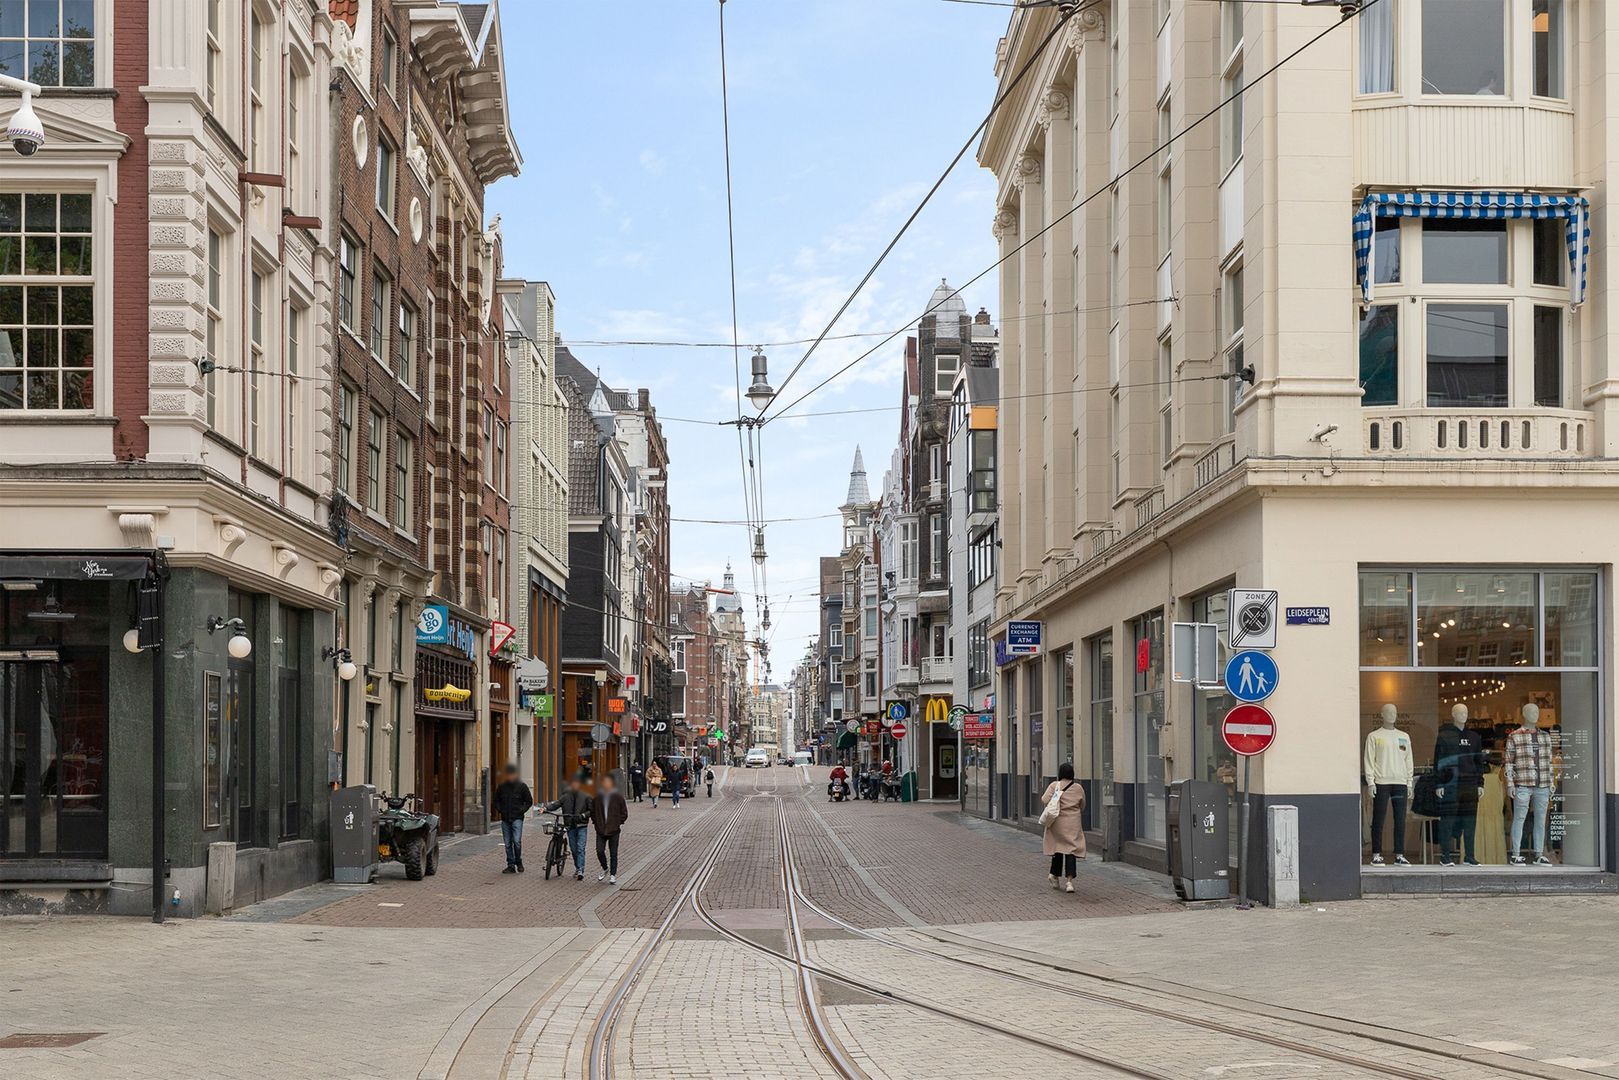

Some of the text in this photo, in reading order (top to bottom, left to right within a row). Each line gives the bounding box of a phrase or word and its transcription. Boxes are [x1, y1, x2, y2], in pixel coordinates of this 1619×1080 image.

[422, 611, 435, 622] to
[1287, 608, 1329, 617] LEIDSEPLEIN
[425, 618, 439, 632] go
[608, 699, 625, 707] WOK
[653, 722, 667, 732] JD
[1550, 803, 1557, 811] -1
